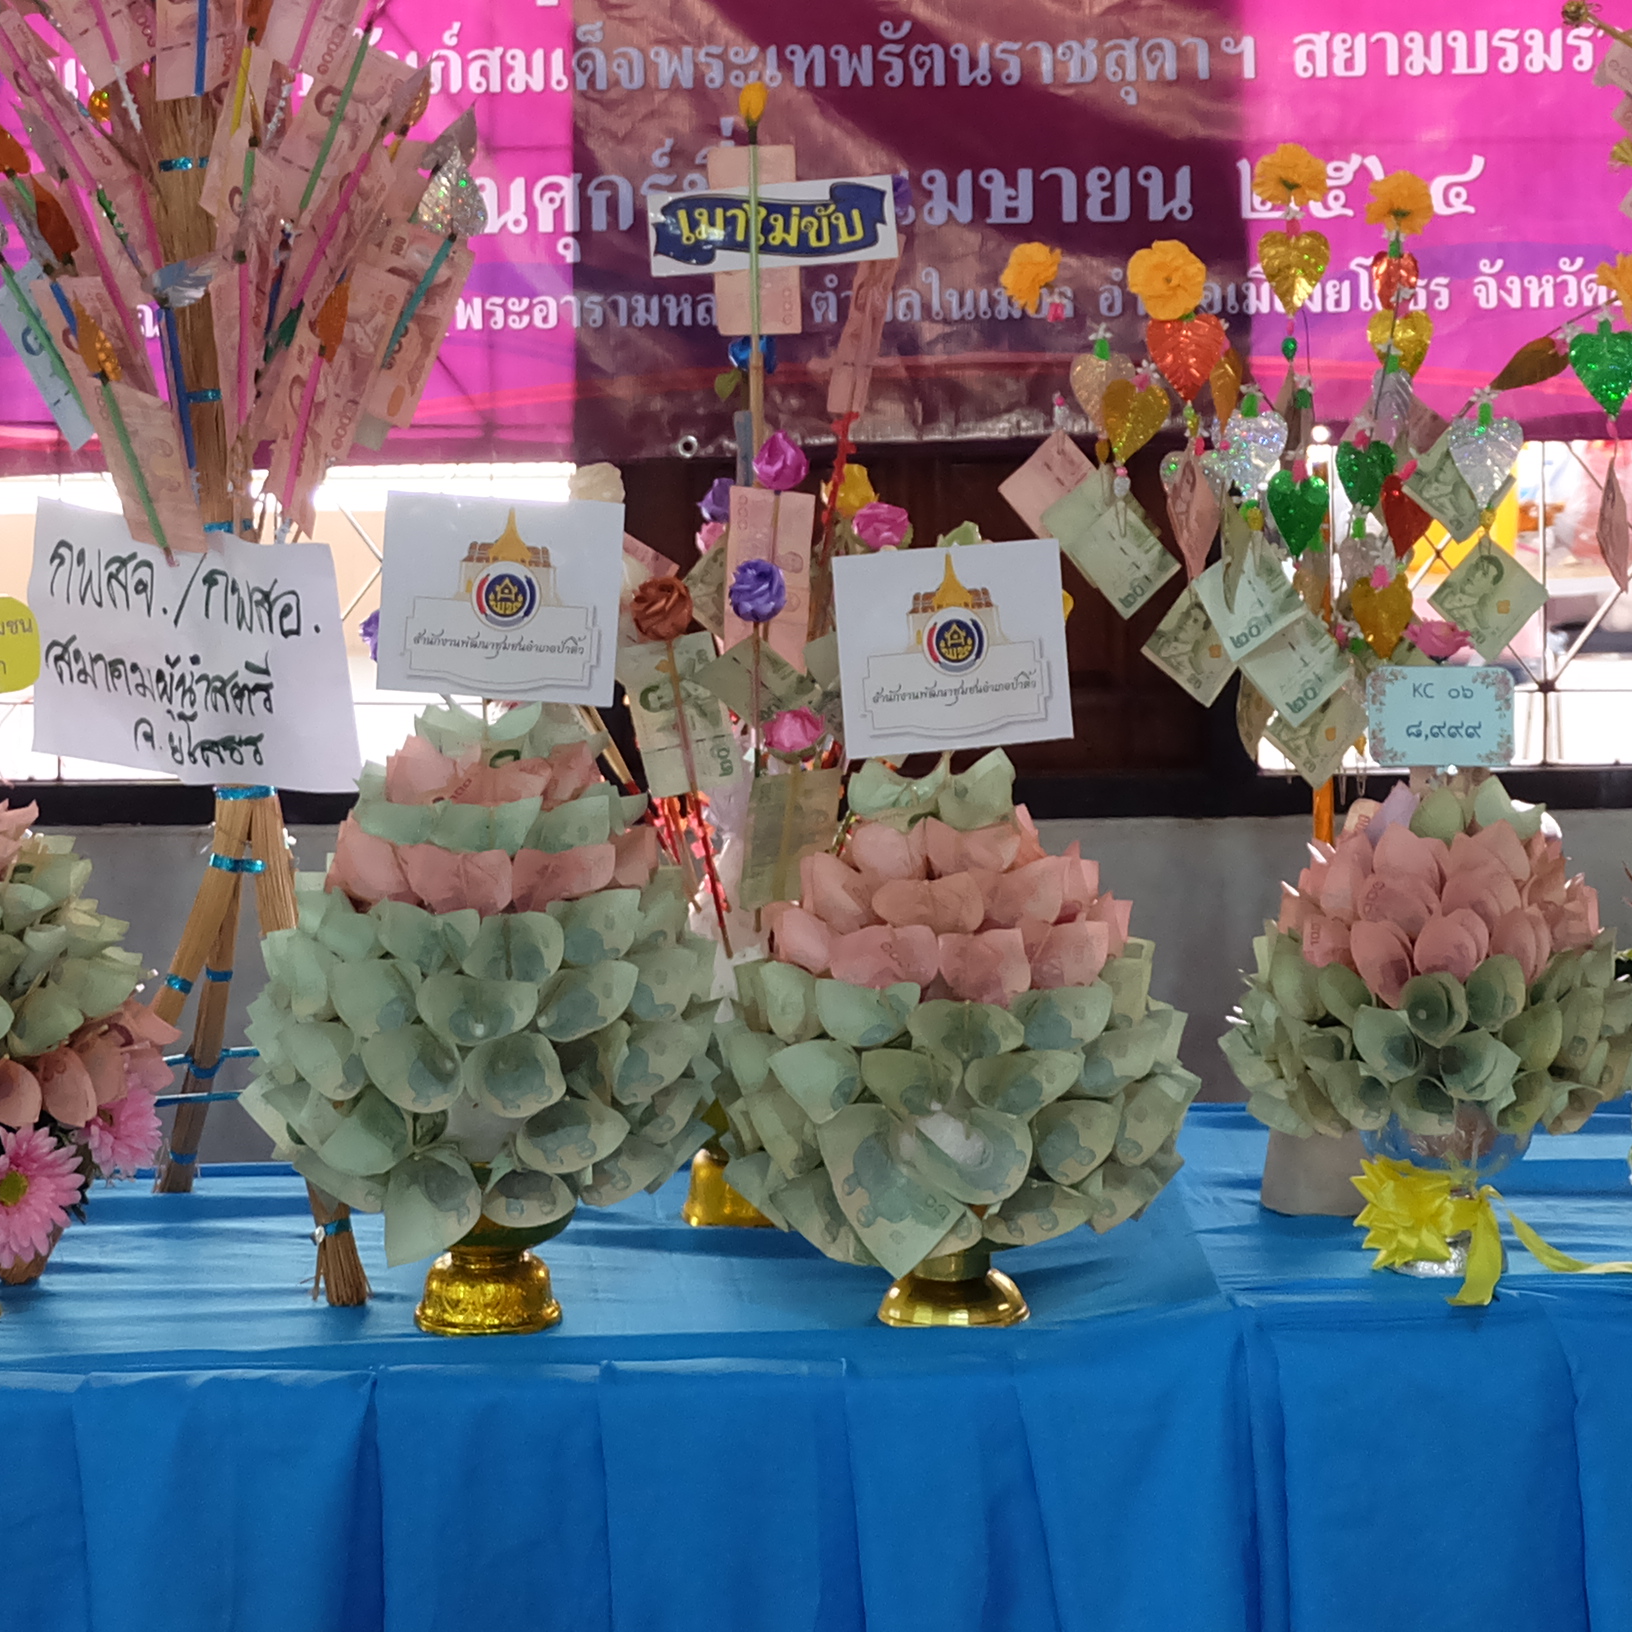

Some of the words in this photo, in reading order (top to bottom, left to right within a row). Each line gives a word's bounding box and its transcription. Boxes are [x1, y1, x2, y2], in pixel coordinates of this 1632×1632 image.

[676, 202, 865, 248] เมาไม่ขับ
[1412, 682, 1435, 699] KC
